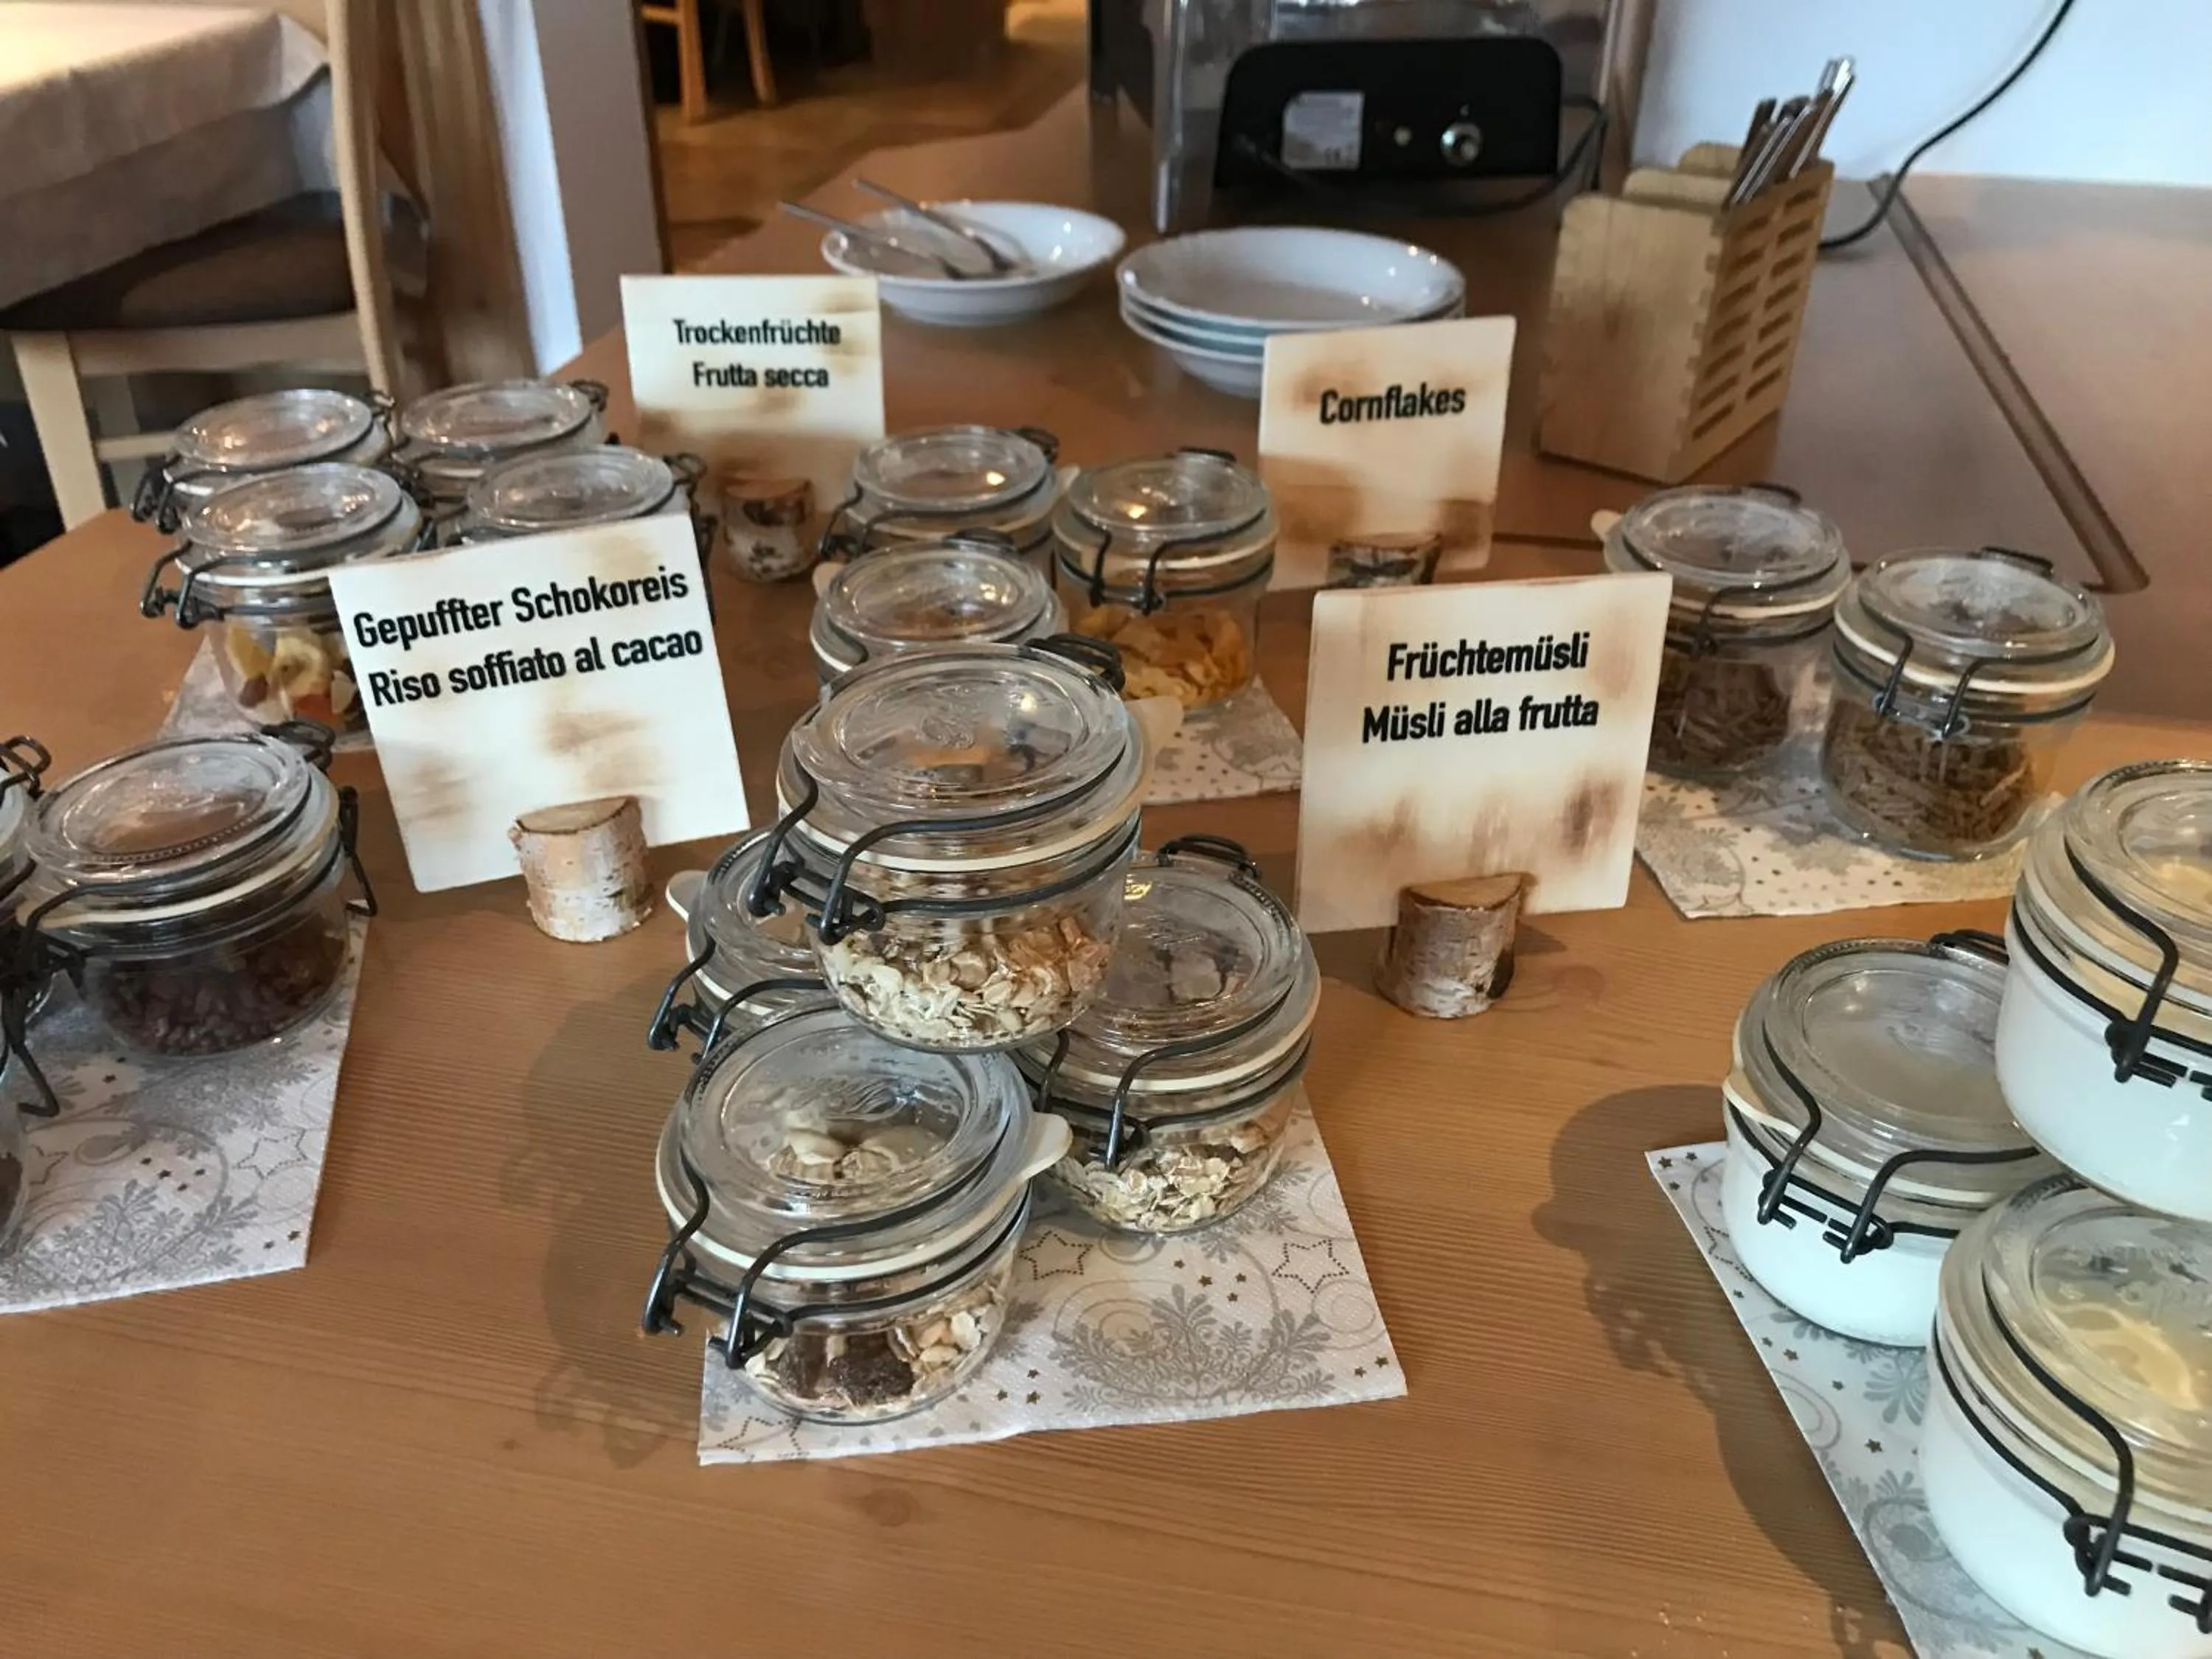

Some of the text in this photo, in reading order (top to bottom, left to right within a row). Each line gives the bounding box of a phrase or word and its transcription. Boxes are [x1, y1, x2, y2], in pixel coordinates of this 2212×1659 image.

[674, 319, 841, 345] Trockenfrüchte
[693, 362, 829, 388] Frutta secca
[1320, 382, 1466, 425] Cornflakes
[352, 566, 689, 650] Gepuffter Schokoreis
[367, 630, 703, 707] Riso soffiato al cacao
[1387, 632, 1590, 681] Früchtemüsli
[1362, 694, 1599, 744] Müsli alla frutta
